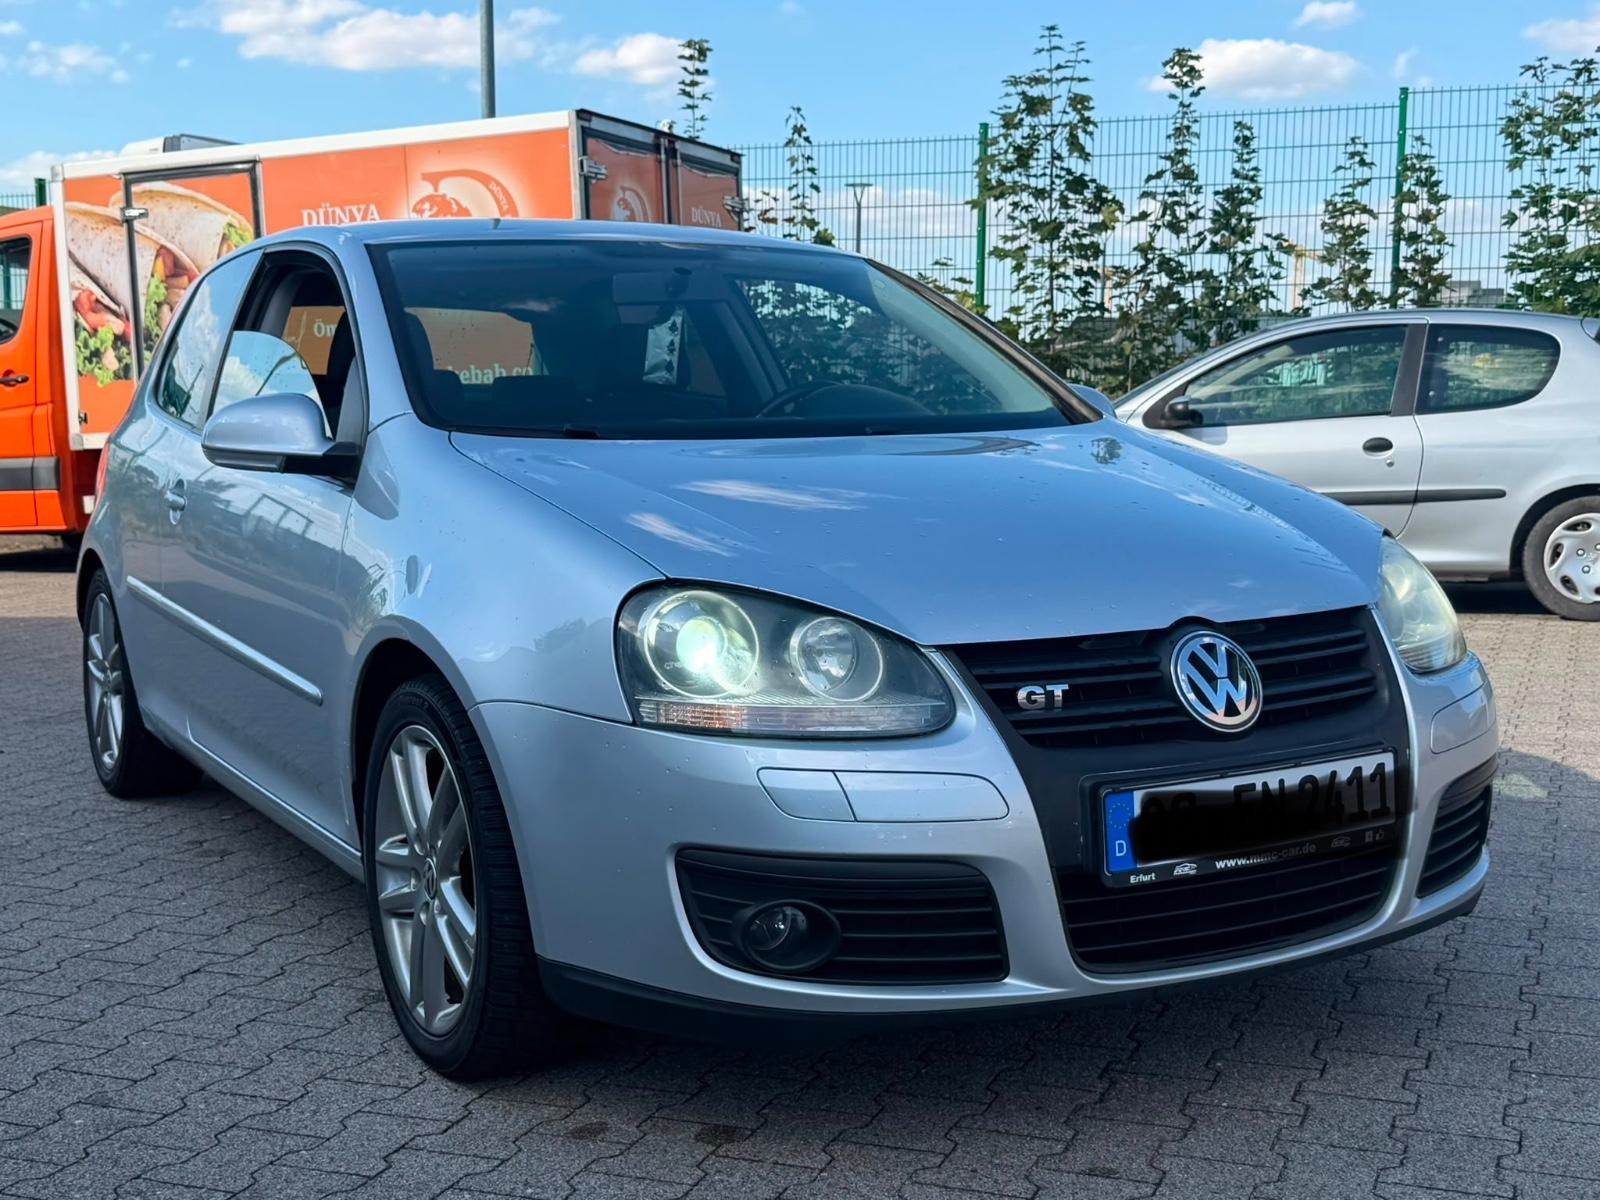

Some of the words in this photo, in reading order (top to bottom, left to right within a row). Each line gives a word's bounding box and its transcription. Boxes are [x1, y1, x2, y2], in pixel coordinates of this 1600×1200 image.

[301, 202, 381, 227] DÜNYA
[691, 205, 722, 228] DÜNYA
[1017, 684, 1069, 711] GT
[1115, 840, 1127, 857] D
[1130, 872, 1156, 884] Erfurt
